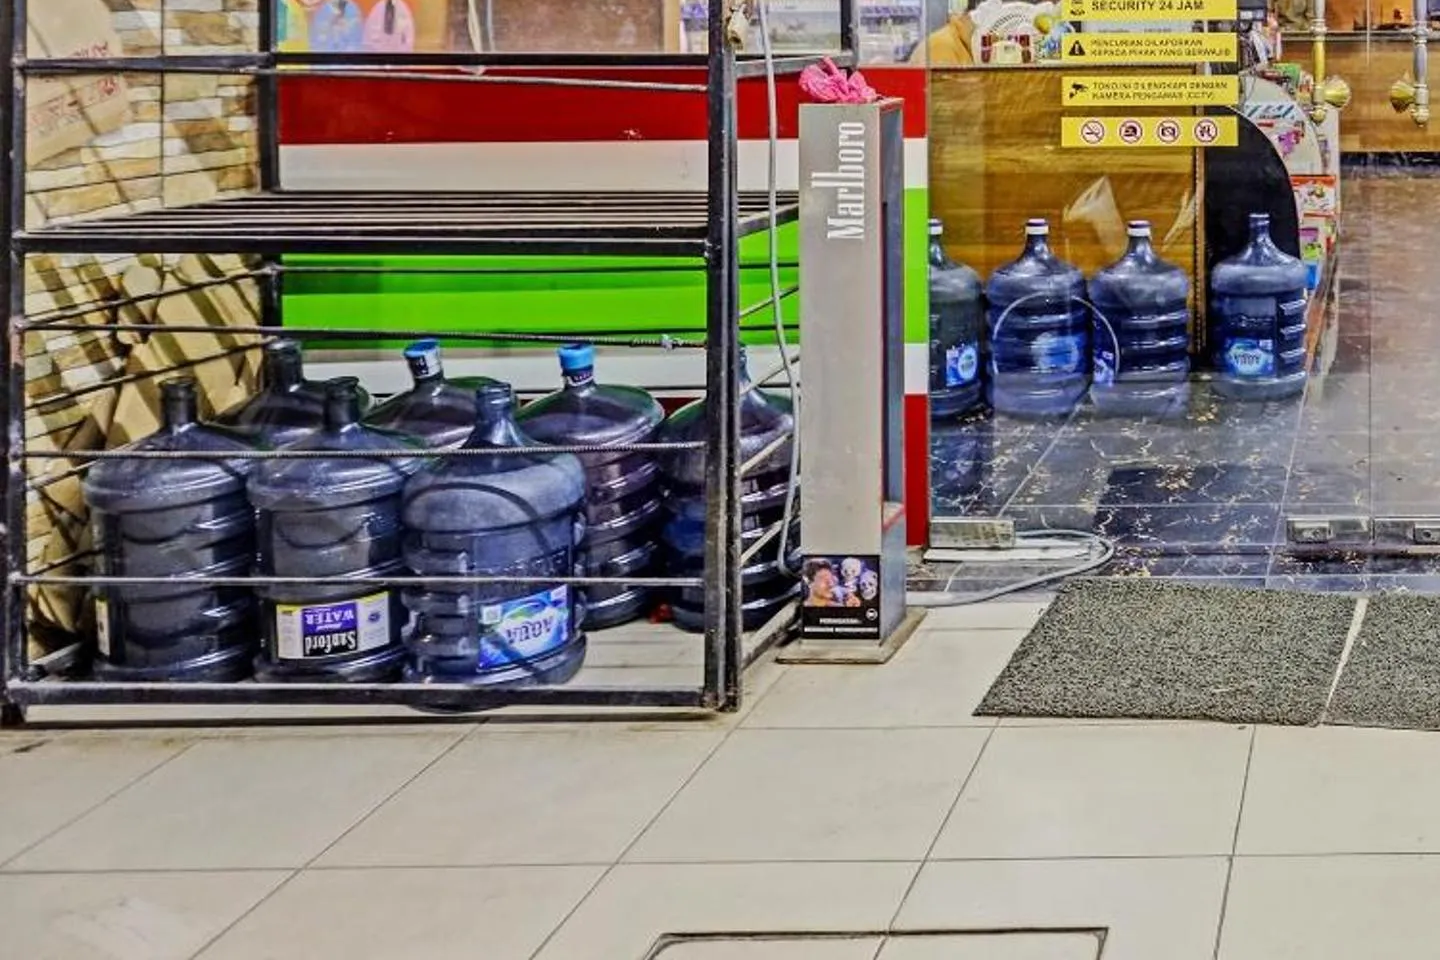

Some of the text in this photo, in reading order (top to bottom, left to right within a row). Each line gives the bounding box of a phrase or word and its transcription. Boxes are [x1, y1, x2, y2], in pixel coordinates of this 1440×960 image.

[1091, 0, 1204, 11] SECURITY 24 JAM
[811, 122, 865, 240] Marlboro
[304, 610, 357, 627] WATER
[504, 613, 555, 645] AQUA
[303, 632, 357, 657] Sanford
